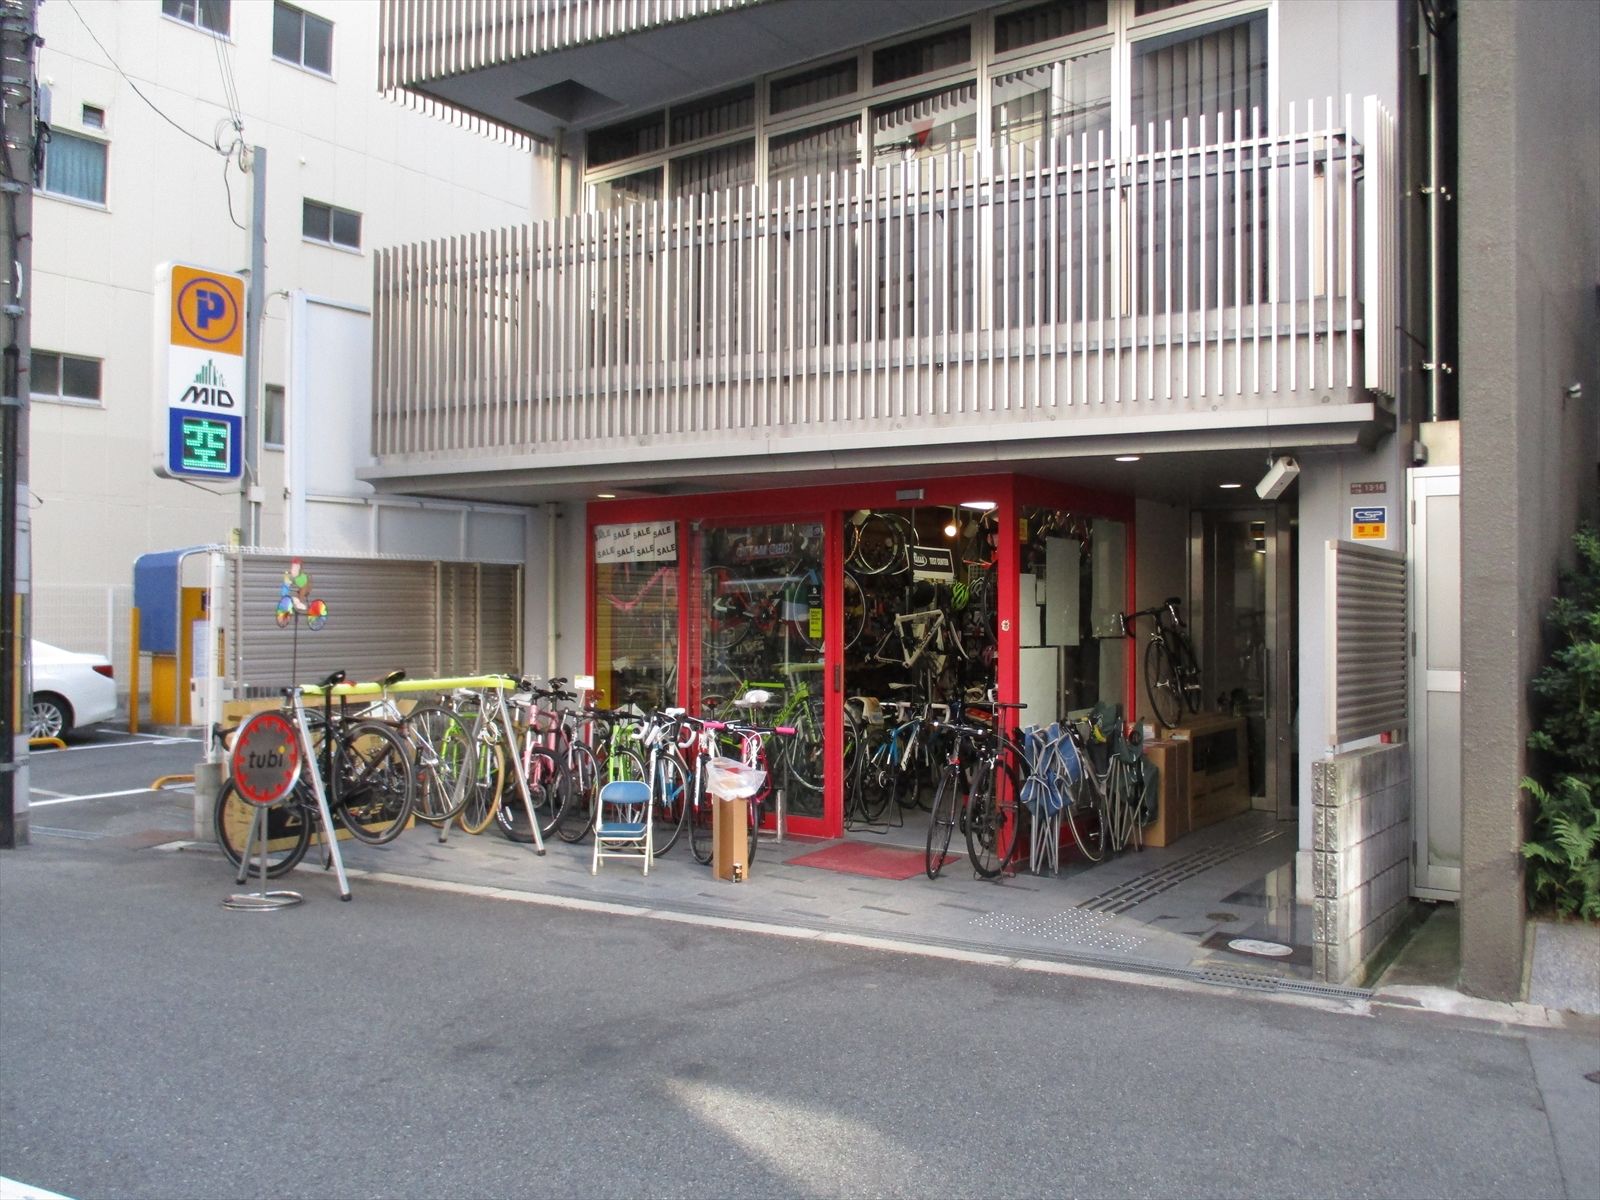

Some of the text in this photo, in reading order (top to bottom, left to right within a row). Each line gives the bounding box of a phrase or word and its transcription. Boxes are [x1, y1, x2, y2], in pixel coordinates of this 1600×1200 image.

[196, 289, 225, 329] P
[181, 386, 234, 408] MID
[183, 421, 227, 470] 空
[1355, 511, 1383, 519] CSP
[613, 528, 631, 540] SALE
[633, 526, 651, 539] SALE
[653, 525, 672, 538] SALE
[617, 545, 635, 557] SALE
[637, 544, 655, 556] SALE
[657, 543, 677, 556] SALE
[248, 745, 285, 769] tubi
